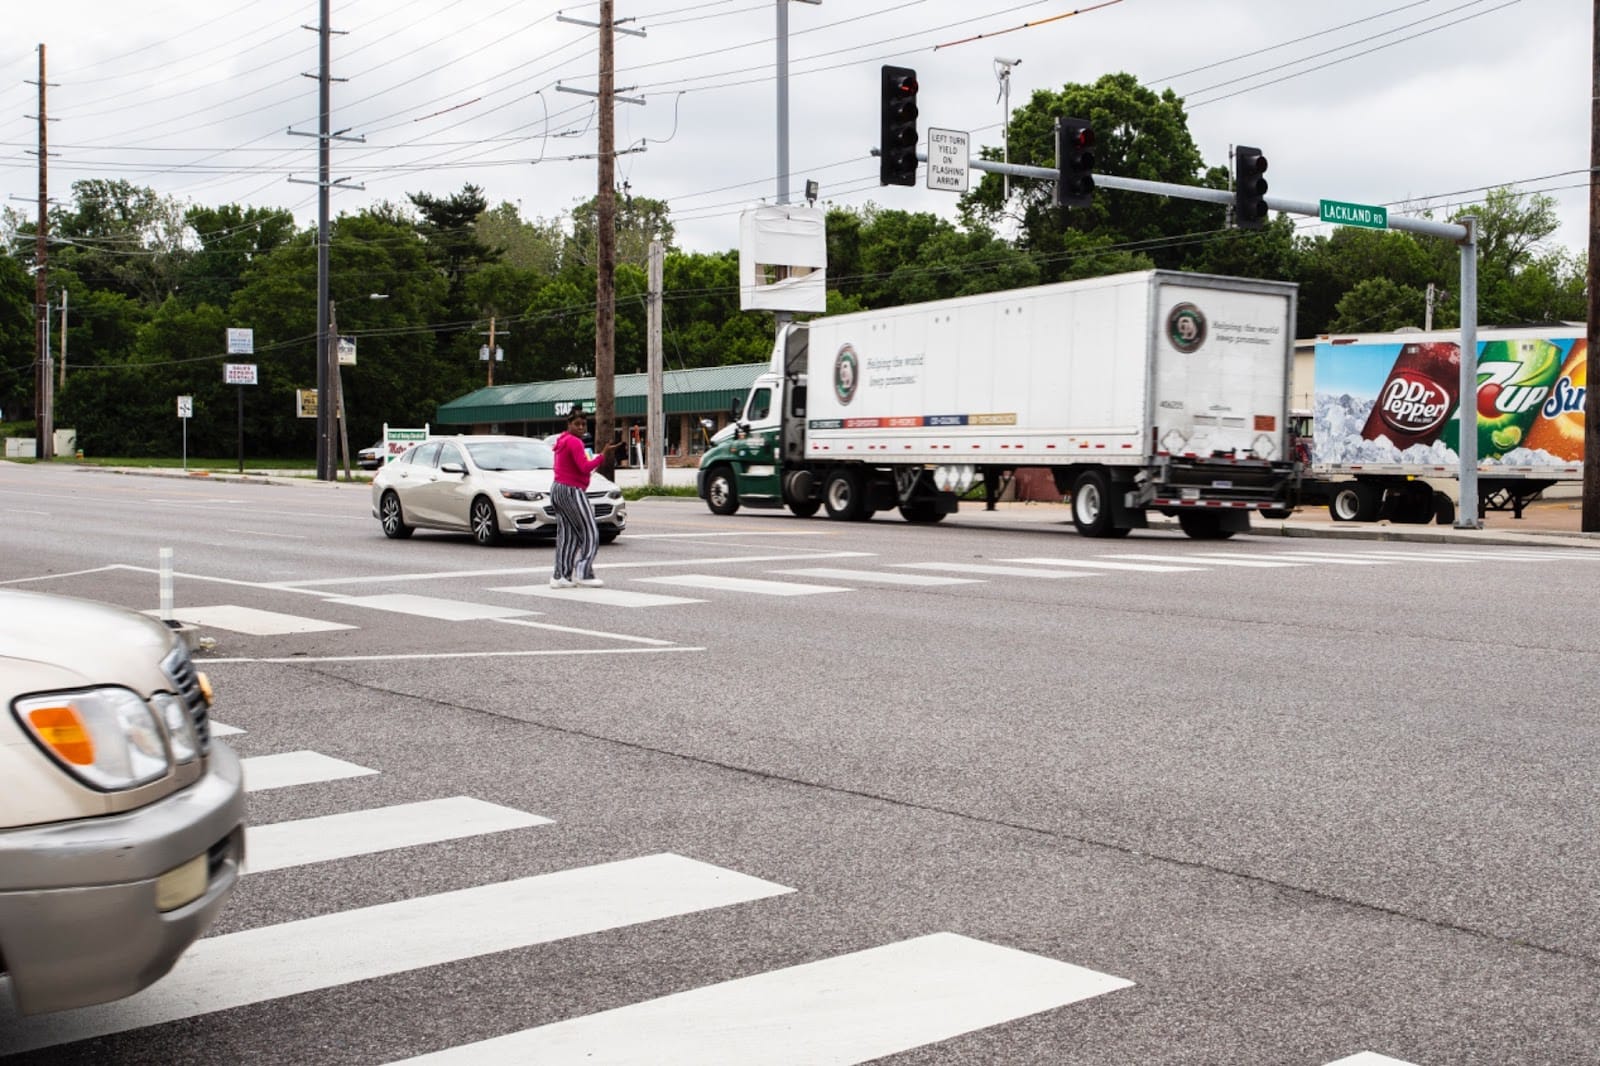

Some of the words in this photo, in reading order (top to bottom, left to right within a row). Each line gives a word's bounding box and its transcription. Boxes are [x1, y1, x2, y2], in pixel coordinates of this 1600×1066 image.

[932, 134, 947, 143] LEFT
[949, 136, 966, 146] TURN
[939, 145, 958, 155] YIELD
[943, 156, 952, 164] ON
[932, 165, 964, 176] FLASHING
[937, 177, 960, 186] ARROW
[1324, 204, 1371, 223] LACKLAND
[1373, 213, 1384, 225] RD
[1404, 381, 1436, 403] Dr
[1543, 376, 1586, 417] Su
[1383, 377, 1445, 422] Pepper
